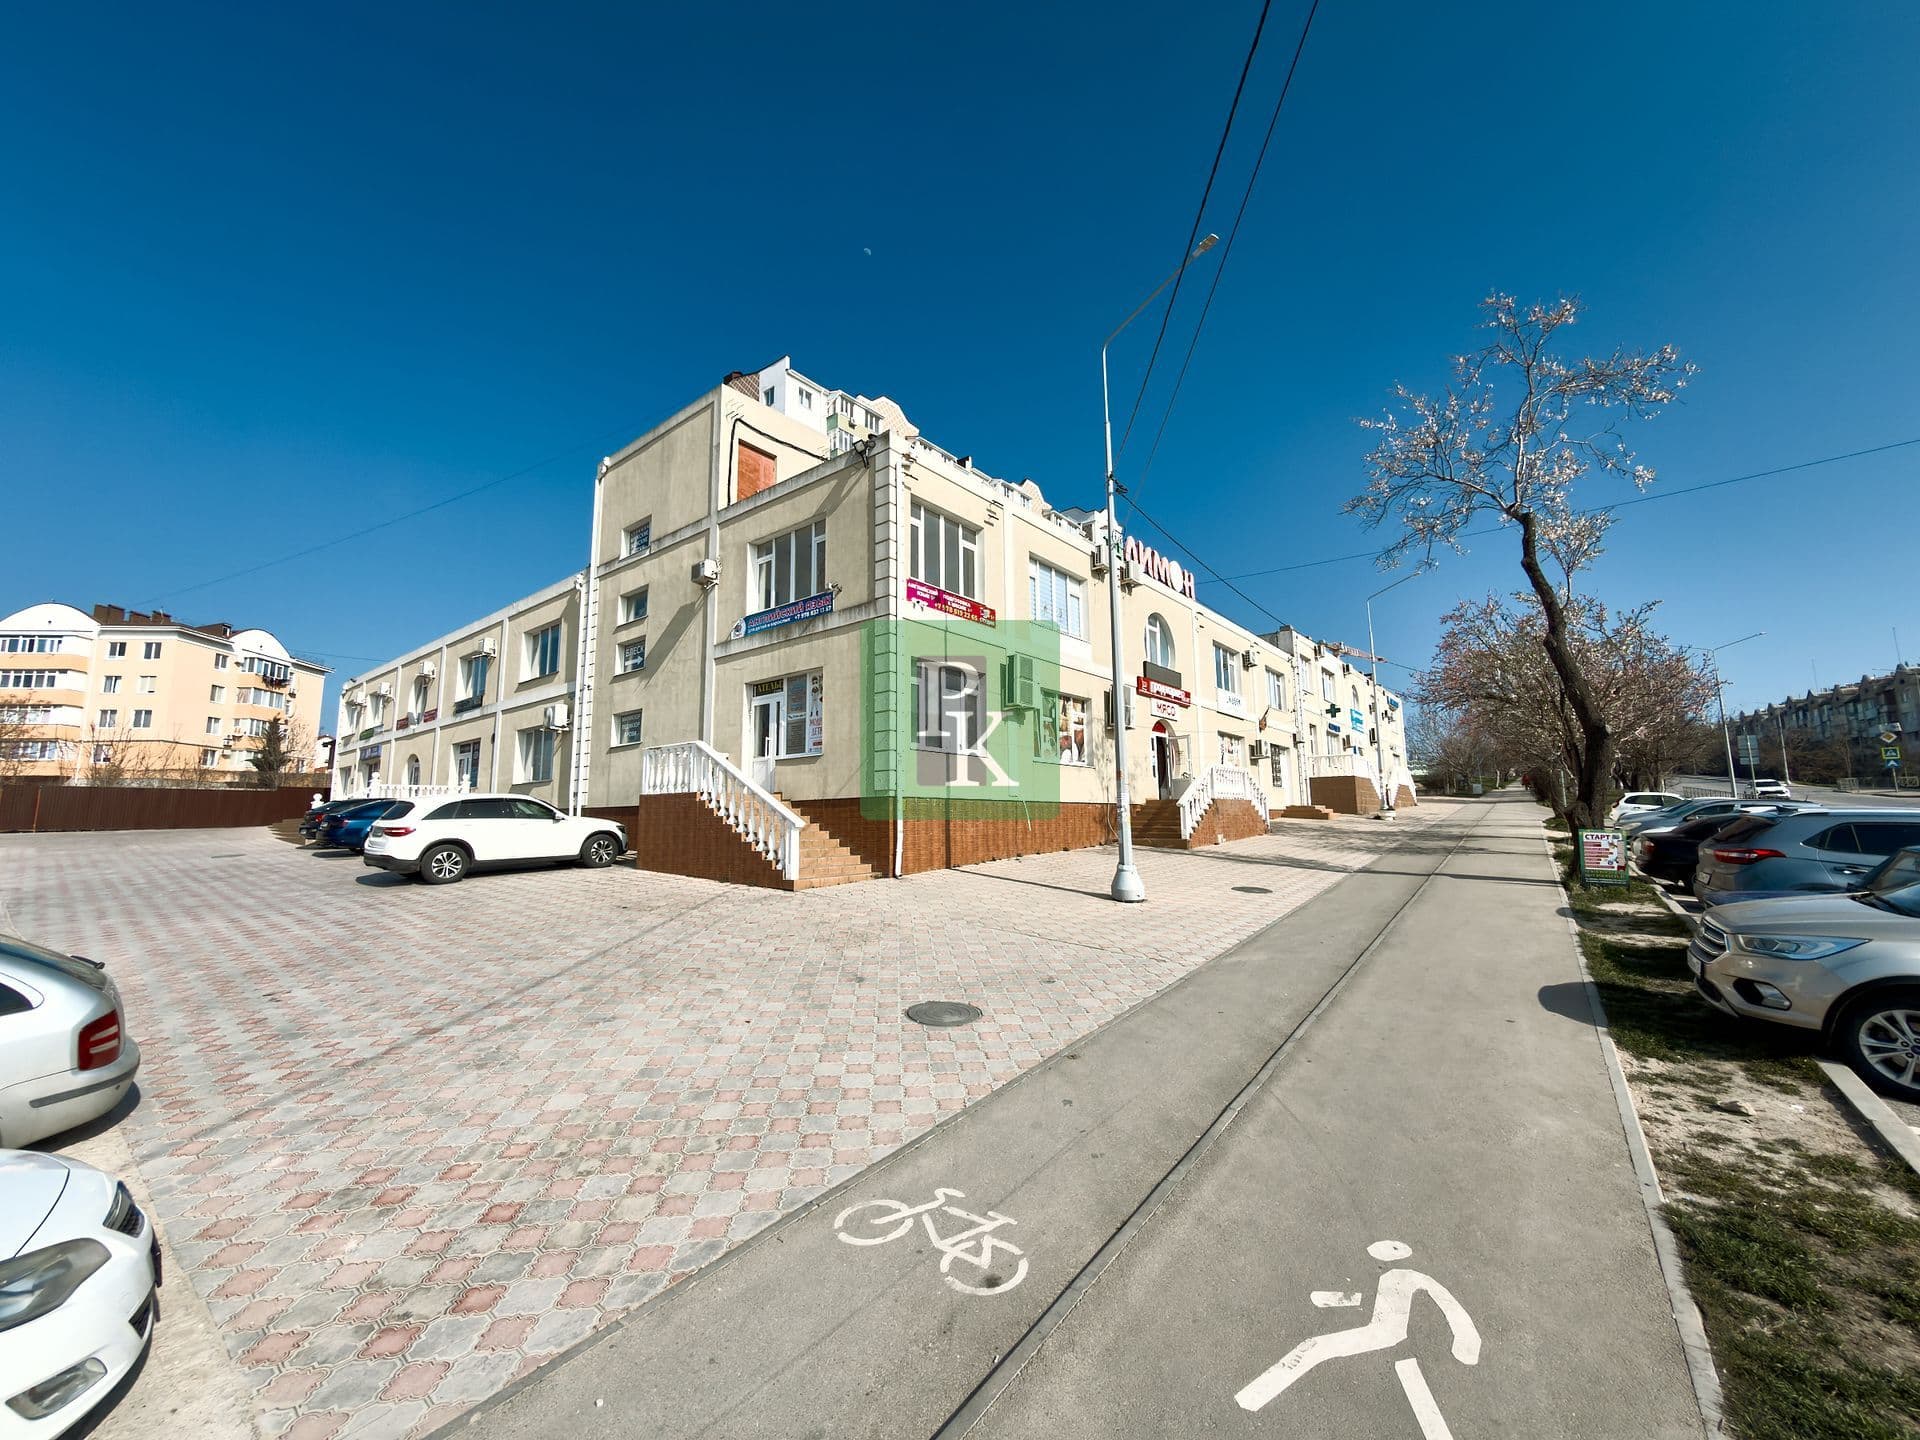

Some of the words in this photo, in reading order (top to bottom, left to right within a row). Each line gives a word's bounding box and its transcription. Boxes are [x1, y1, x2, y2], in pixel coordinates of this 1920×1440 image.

[1125, 535, 1195, 601] ЛИМОН
[748, 601, 805, 627] АНГЛИЙСКИЙ
[805, 594, 832, 611] ЯЗЫК
